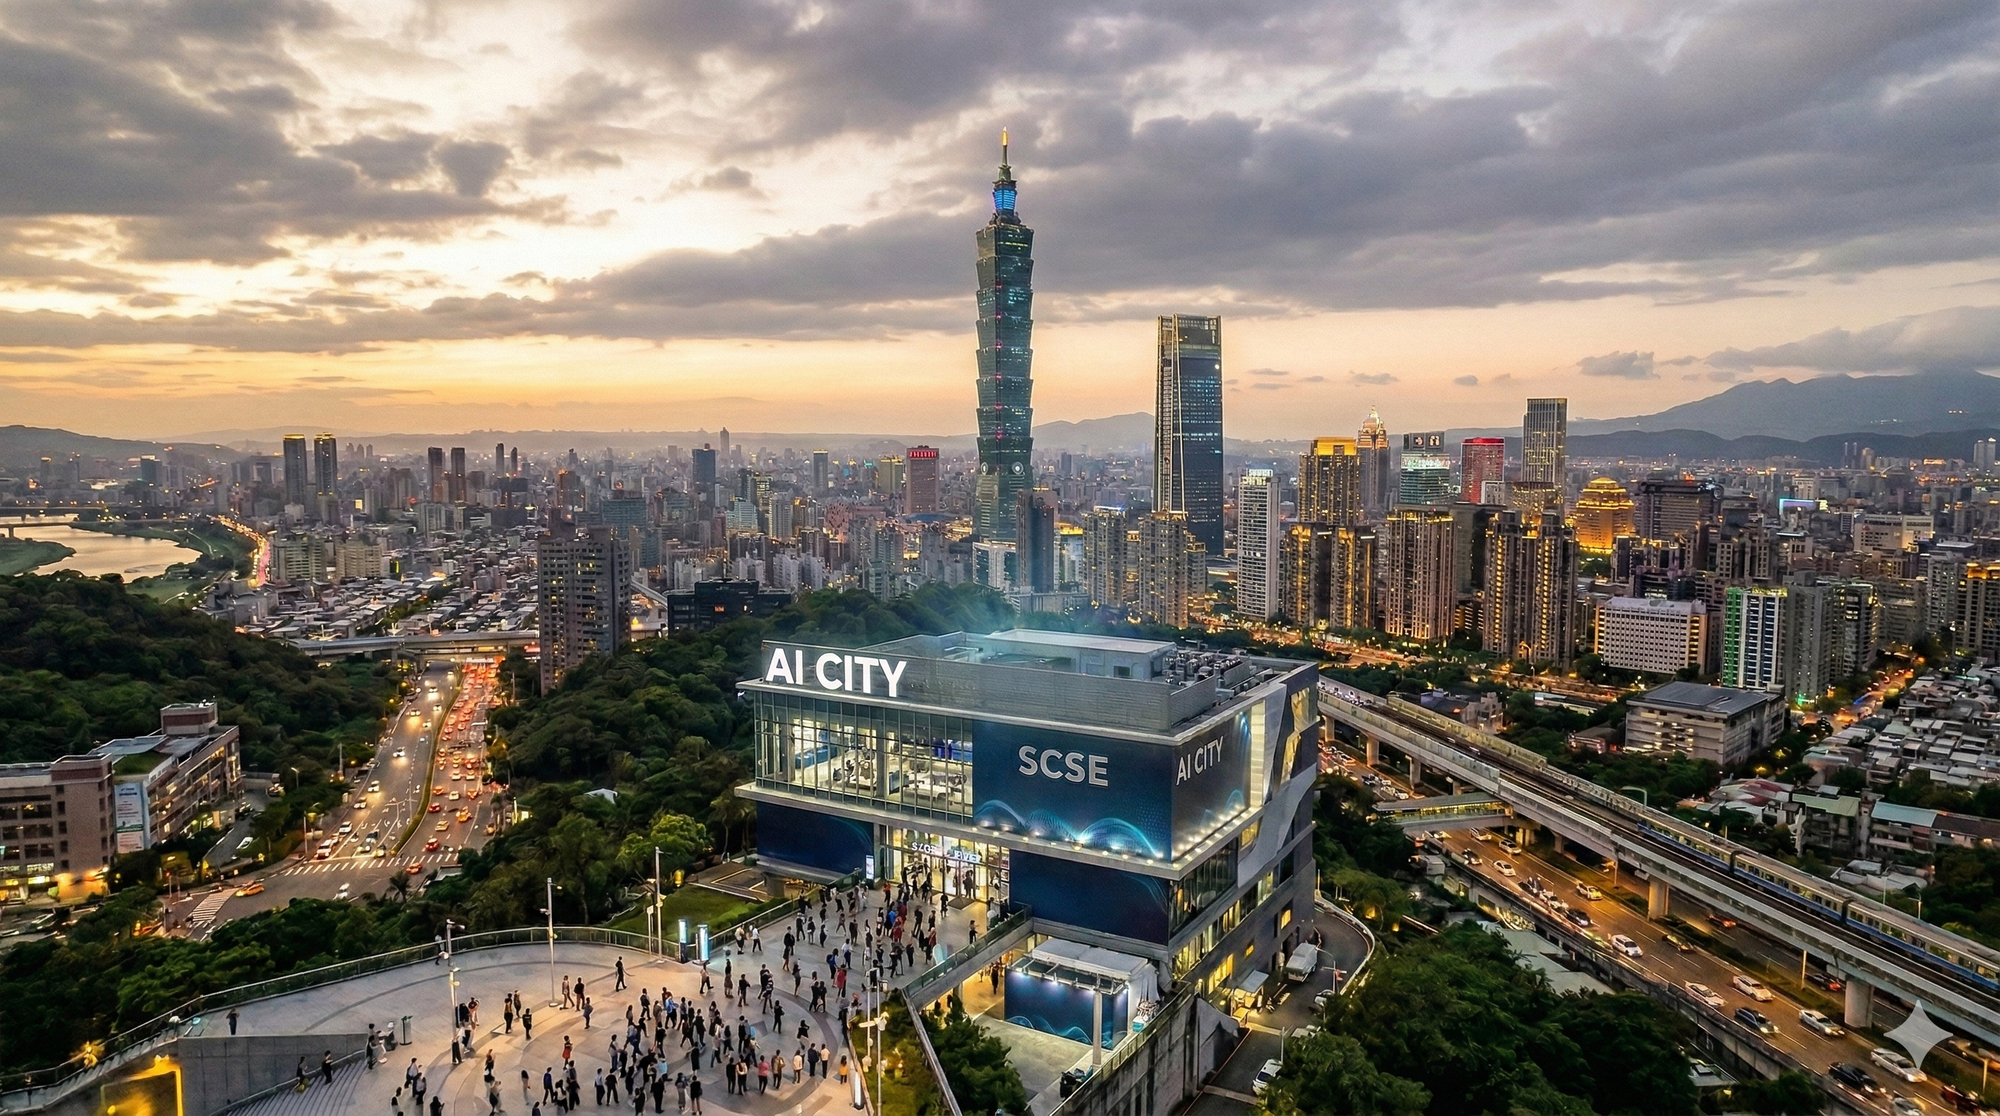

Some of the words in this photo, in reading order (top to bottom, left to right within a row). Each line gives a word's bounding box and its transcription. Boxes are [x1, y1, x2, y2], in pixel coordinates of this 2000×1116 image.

[765, 648, 803, 685] AI
[815, 652, 907, 698] CITY
[1018, 745, 1109, 787] SCSE
[1176, 753, 1191, 786] AI
[1194, 735, 1224, 774] CITY
